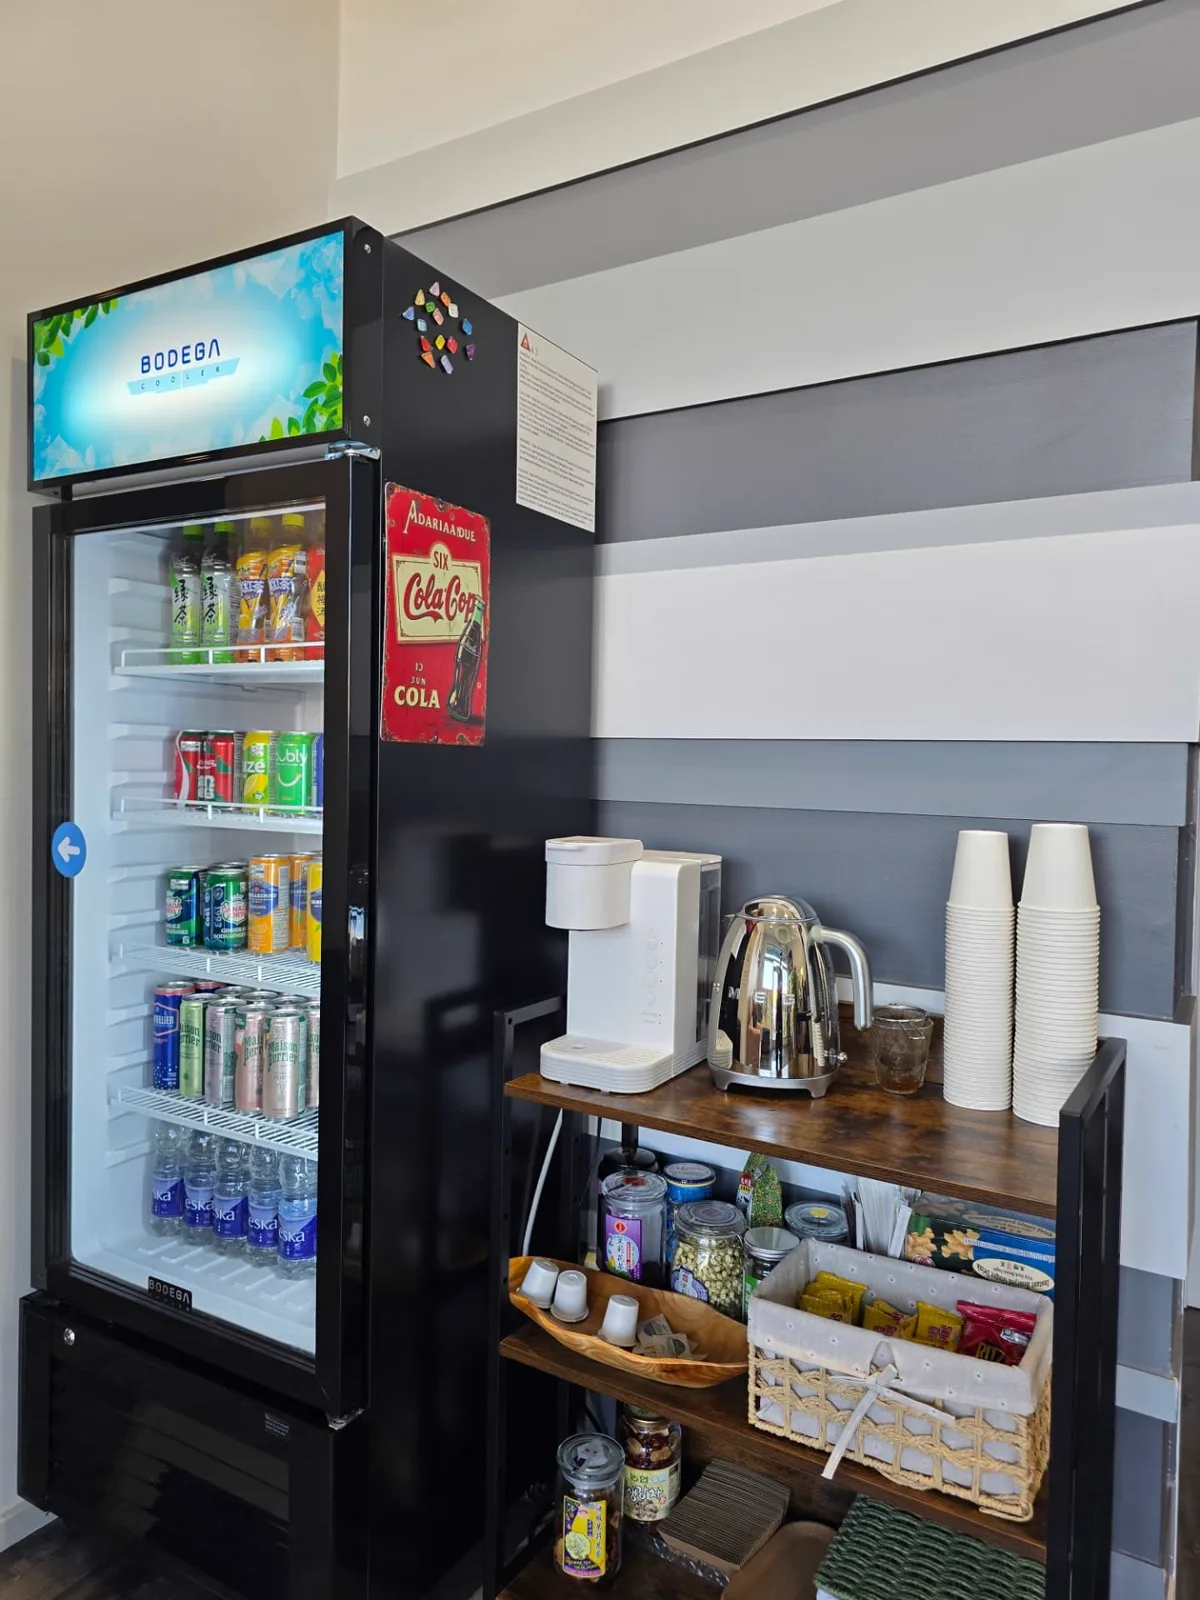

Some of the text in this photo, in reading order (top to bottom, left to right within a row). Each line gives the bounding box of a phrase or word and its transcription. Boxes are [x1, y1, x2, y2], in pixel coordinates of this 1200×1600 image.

[141, 339, 221, 374] BODEGA
[140, 366, 220, 390] COOLER
[433, 551, 449, 571] SIX
[394, 685, 440, 709] COLA
[276, 748, 308, 764] ubly
[248, 1216, 278, 1231] eska
[149, 1279, 190, 1304] BODEGA
